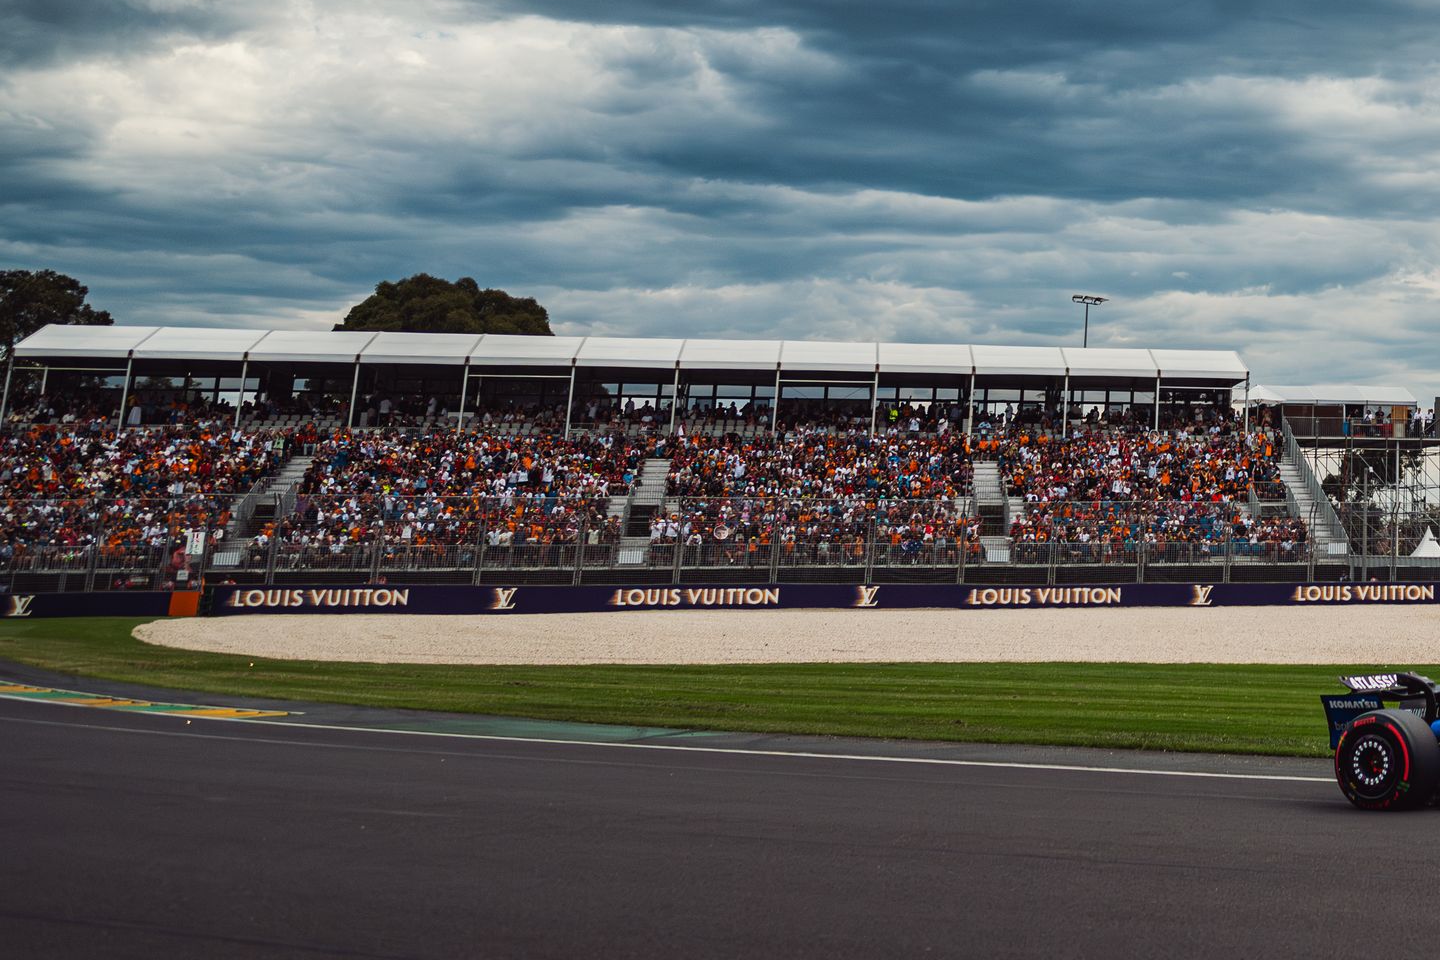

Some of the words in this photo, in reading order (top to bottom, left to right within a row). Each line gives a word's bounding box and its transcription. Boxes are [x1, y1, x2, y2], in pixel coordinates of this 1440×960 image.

[233, 589, 304, 607] LOUIS
[310, 588, 409, 606] VUITTON
[615, 588, 681, 606] LOUIS
[687, 587, 779, 605] VUITTON
[971, 587, 1031, 605] LOUIS
[1037, 587, 1122, 604] VUITTON
[1297, 585, 1352, 601] LOUIS
[1357, 585, 1434, 601] VUITTON
[1328, 698, 1379, 709] KOMATSU
